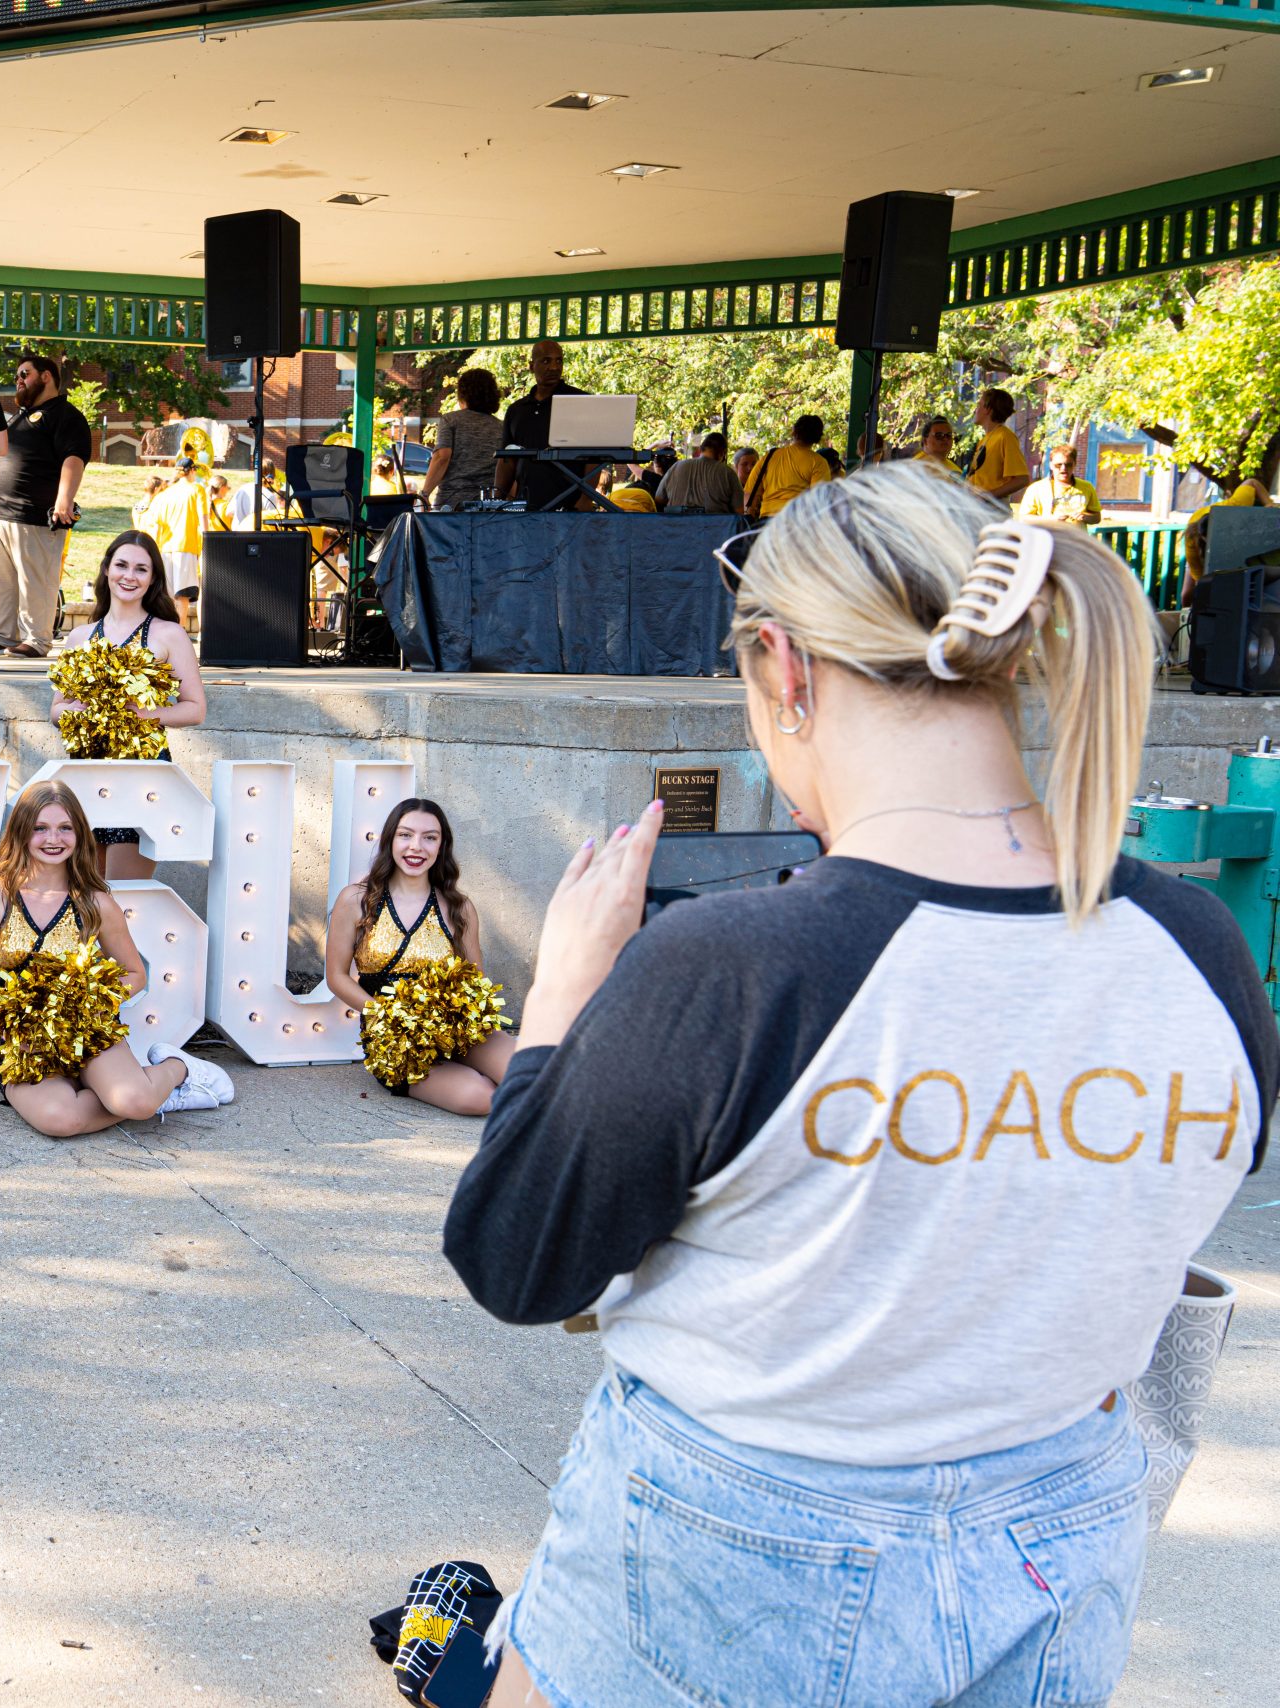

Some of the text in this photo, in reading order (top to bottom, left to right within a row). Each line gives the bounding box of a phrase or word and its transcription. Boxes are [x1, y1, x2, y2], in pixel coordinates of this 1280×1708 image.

[661, 775, 715, 785] BUCK'S STAGE
[802, 1067, 1239, 1166] COACH
[1178, 1334, 1213, 1354] MK
[1136, 1381, 1169, 1401] MK
[1177, 1374, 1210, 1391] MK
